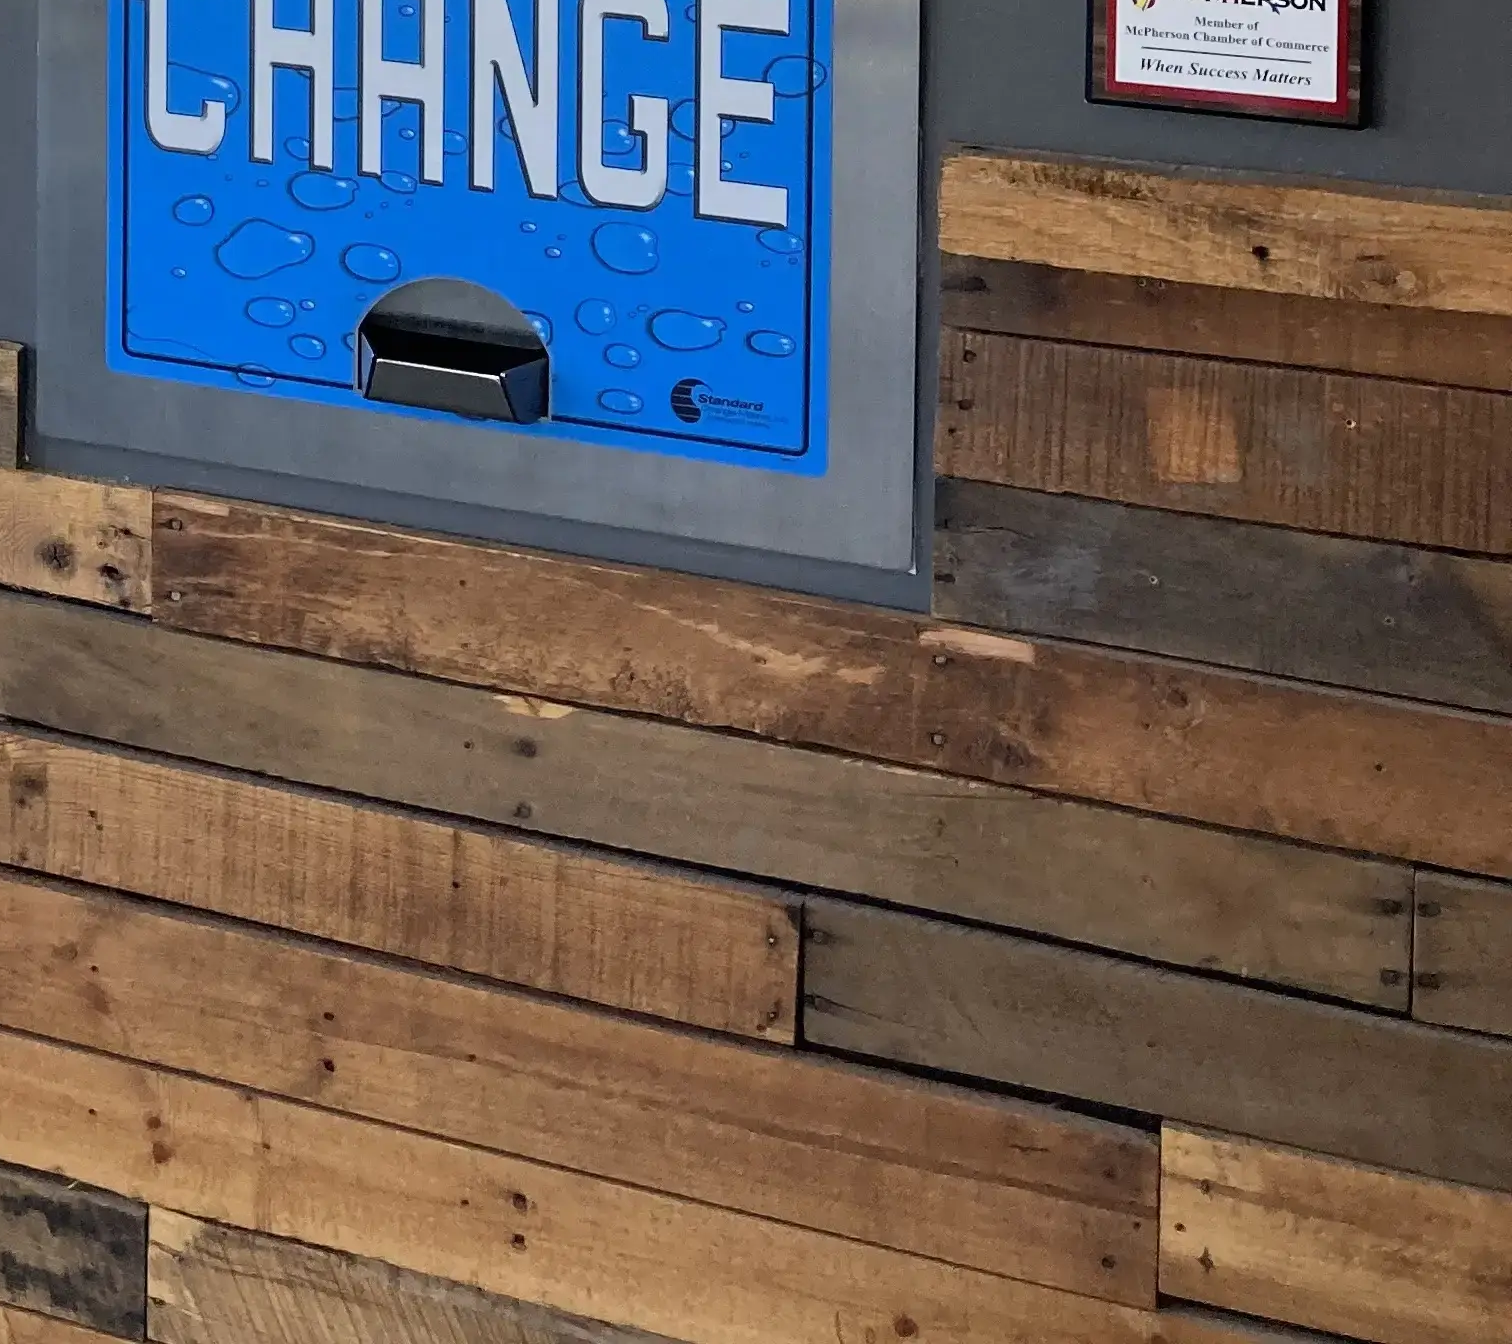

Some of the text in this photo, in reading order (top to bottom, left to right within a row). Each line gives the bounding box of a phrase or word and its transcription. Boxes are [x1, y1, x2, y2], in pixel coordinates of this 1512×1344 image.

[1193, 16, 1260, 32] Member of
[1124, 24, 1330, 54] McPherson Chamber of Commerce
[1139, 57, 1313, 87] When Success Matters
[697, 392, 765, 412] Standard
